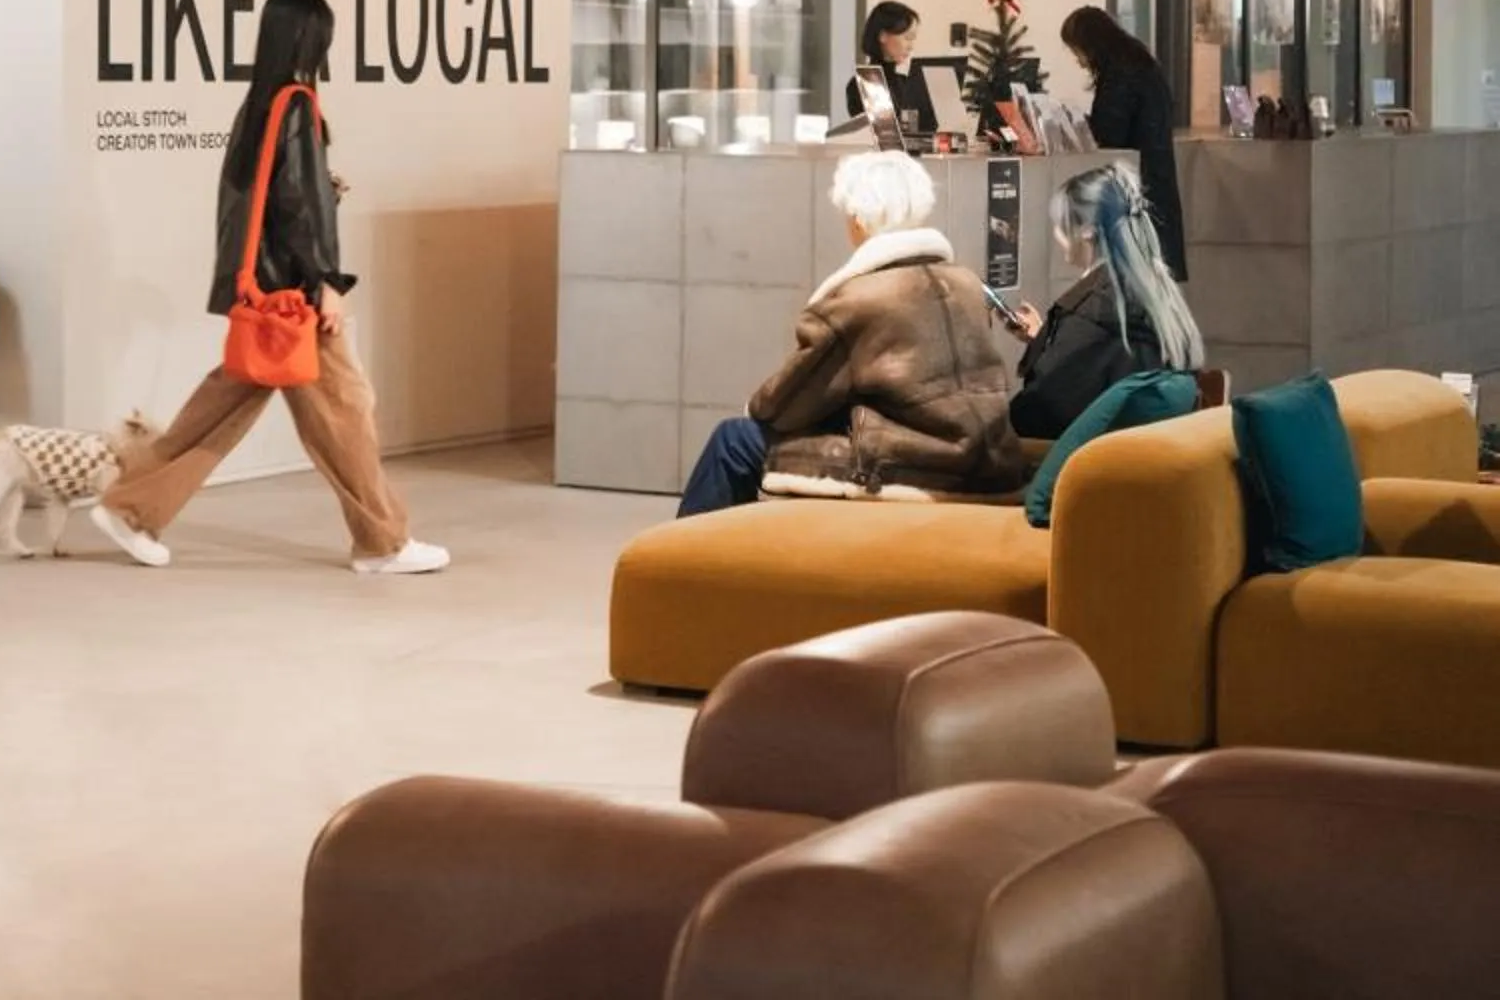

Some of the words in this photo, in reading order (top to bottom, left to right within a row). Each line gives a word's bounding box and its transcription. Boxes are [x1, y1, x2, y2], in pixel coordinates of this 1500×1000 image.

[97, 111, 139, 127] LOCAL
[143, 111, 187, 127] STITCH
[97, 134, 156, 151] CREATOR
[160, 133, 197, 150] TOWN
